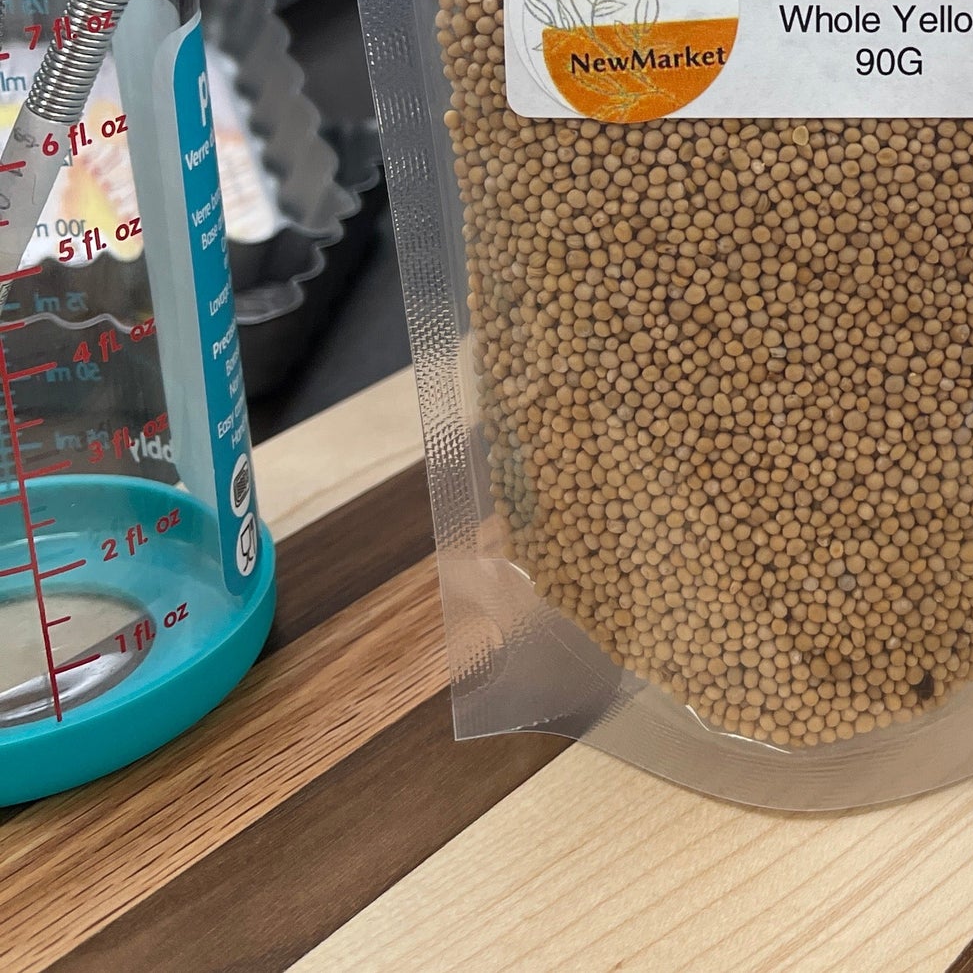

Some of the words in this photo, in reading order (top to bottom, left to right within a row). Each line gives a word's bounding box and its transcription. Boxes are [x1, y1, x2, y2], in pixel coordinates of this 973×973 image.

[24, 24, 42, 50] 7
[52, 16, 78, 50] fl.
[87, 10, 115, 33] oz
[779, 4, 881, 33] Whole
[570, 45, 726, 74] NewMarket
[856, 46, 923, 75] 90G
[42, 132, 59, 156] 6
[68, 122, 93, 156] fl.
[101, 114, 128, 138] oz
[184, 139, 210, 171] Verre
[58, 237, 75, 262] 5
[82, 227, 107, 260] fl.
[115, 217, 142, 241] oz
[72, 341, 92, 363] 4
[130, 317, 156, 342] oz
[88, 440, 104, 464] 3
[143, 412, 169, 438] oz
[101, 538, 119, 562] 2
[156, 508, 181, 534] oz
[114, 634, 127, 654] 1
[163, 602, 189, 628] oz
